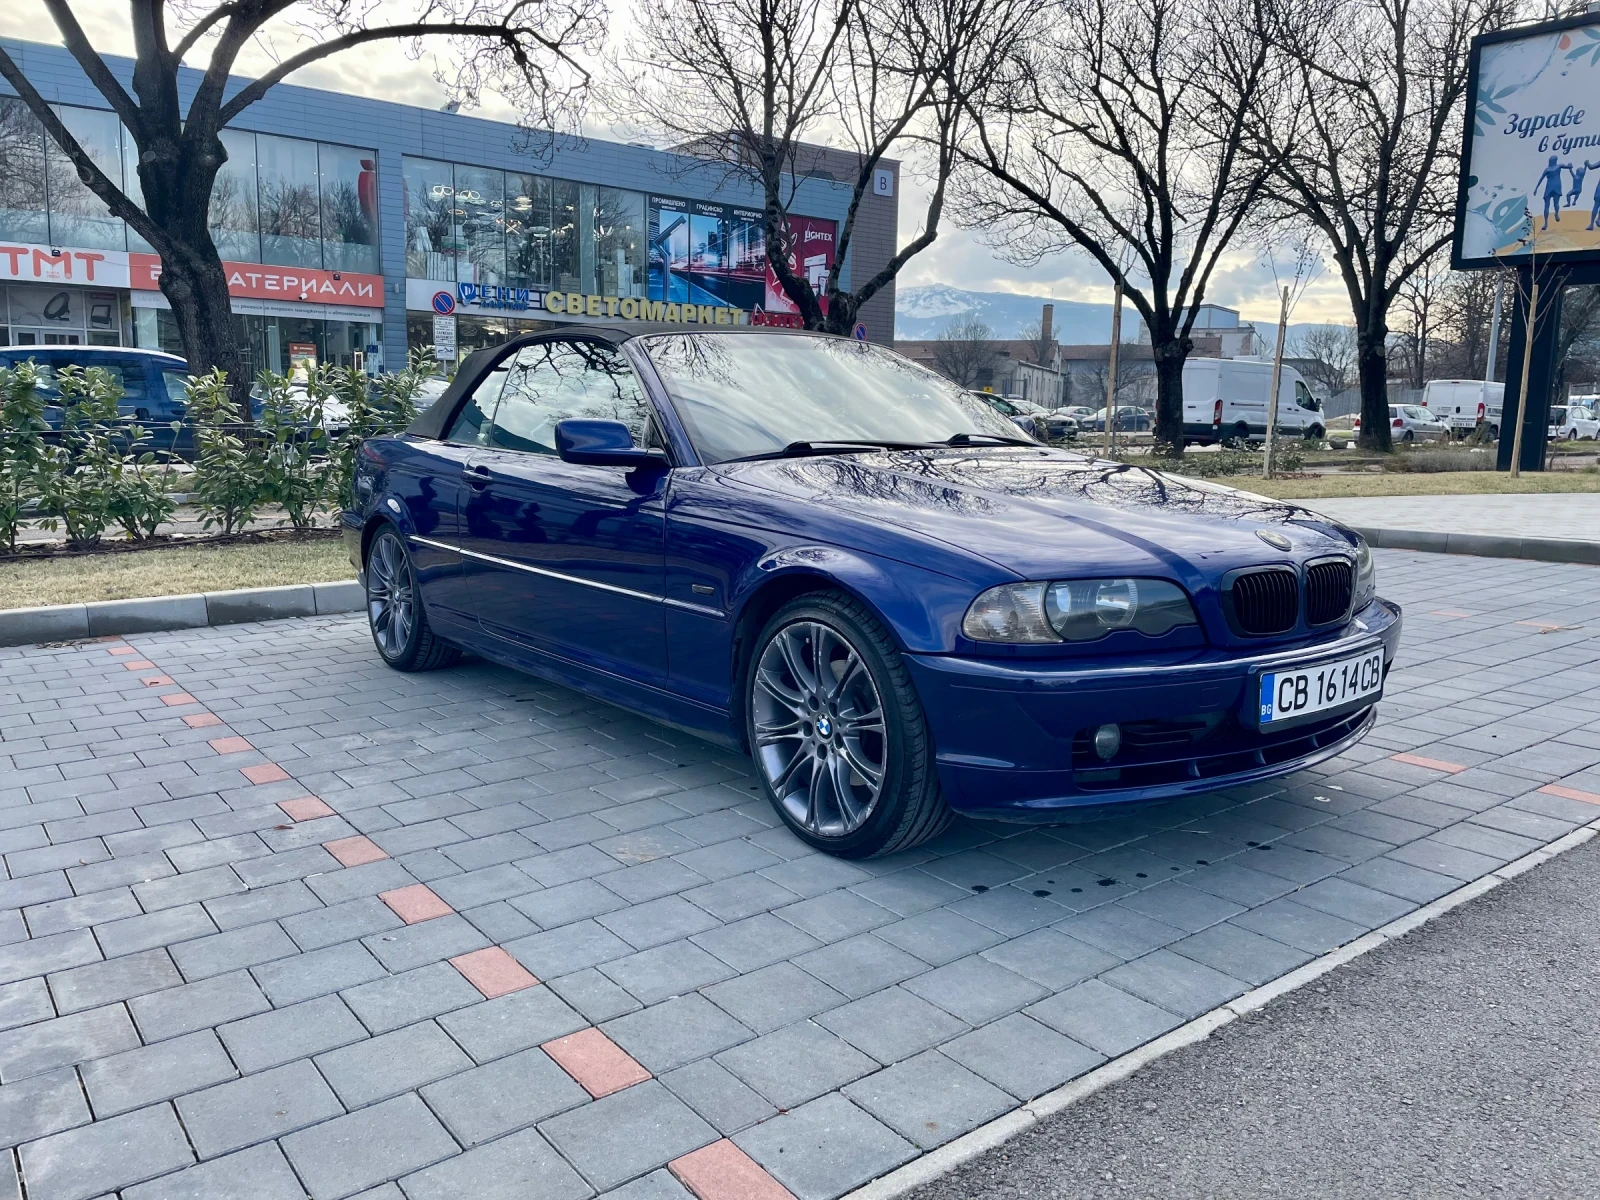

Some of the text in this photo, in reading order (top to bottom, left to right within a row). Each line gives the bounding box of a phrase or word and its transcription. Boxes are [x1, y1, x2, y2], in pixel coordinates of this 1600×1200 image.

[1503, 105, 1585, 139] Здраве
[1538, 135, 1549, 153] в
[804, 228, 832, 243] LIGHTEX
[228, 271, 373, 298] АТЕРИАЛИ
[545, 291, 744, 325] СВЕТОМАРКЕТ
[1278, 675, 1308, 712] CB
[1261, 703, 1272, 716] BG
